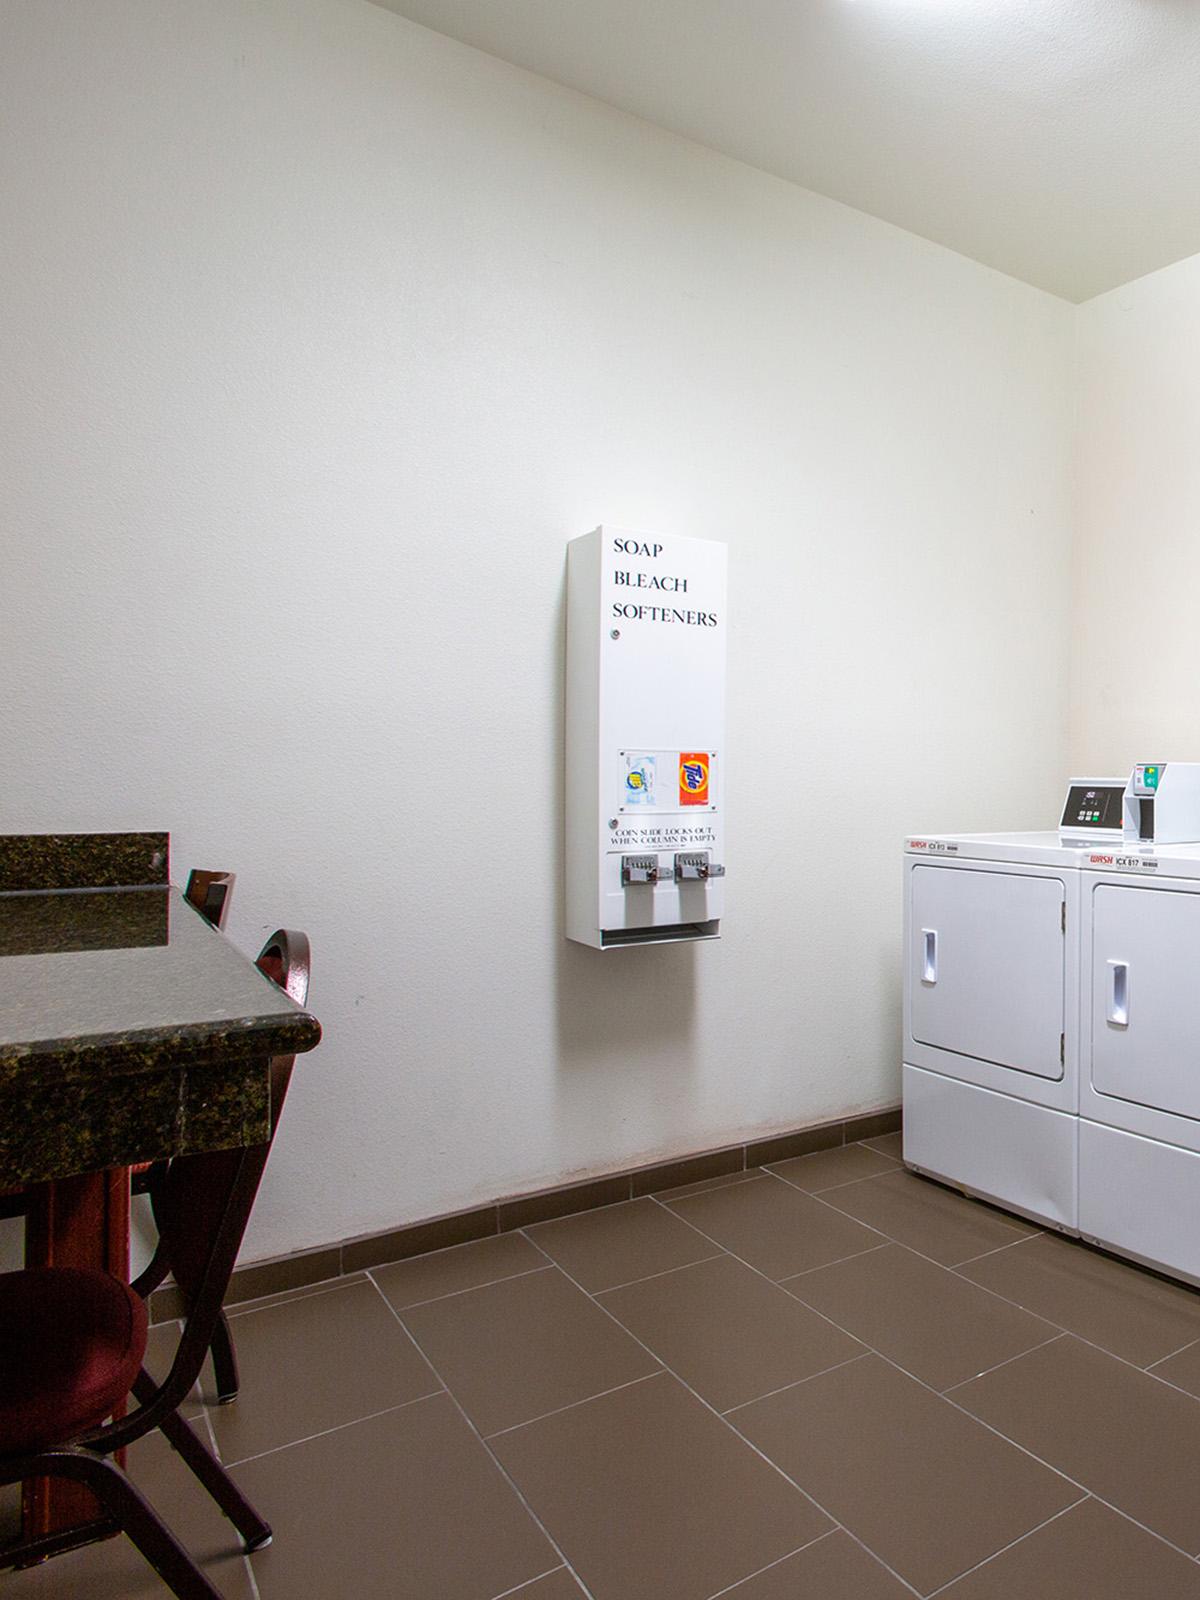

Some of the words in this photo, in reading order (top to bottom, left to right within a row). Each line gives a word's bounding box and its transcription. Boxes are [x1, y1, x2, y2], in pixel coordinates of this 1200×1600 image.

[613, 538, 663, 557] SOAP
[614, 571, 687, 592] BLEACH
[613, 603, 717, 627] SOFTENERS
[683, 764, 702, 790] Tide
[611, 837, 637, 845] WHEN
[641, 836, 678, 844] COLUMN
[689, 834, 716, 842] EMPTY
[615, 828, 637, 836] COIN
[641, 828, 661, 836] SLIDE
[1090, 855, 1113, 864] WASH
